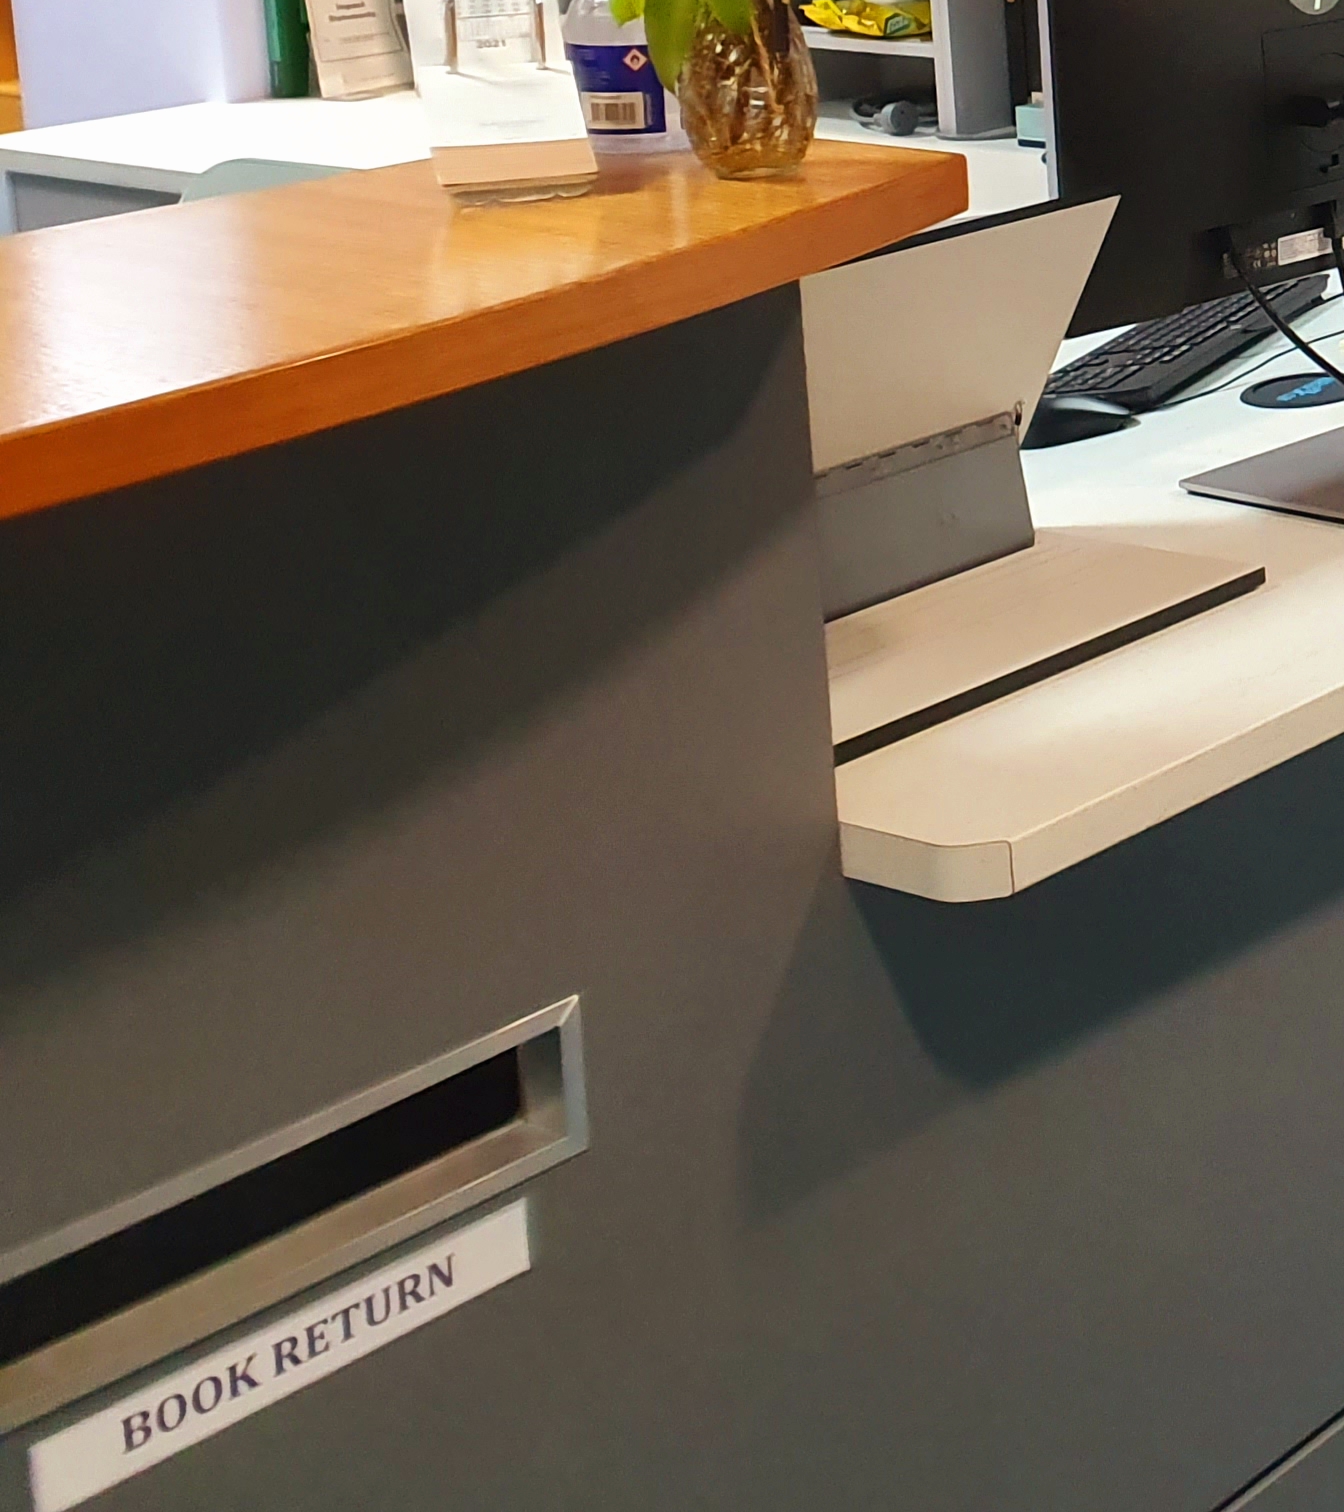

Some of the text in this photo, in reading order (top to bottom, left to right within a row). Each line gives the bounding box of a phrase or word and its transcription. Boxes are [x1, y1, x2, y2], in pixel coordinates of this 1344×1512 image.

[475, 38, 507, 50] 2021
[120, 1253, 457, 1455] BOOK RETURN
